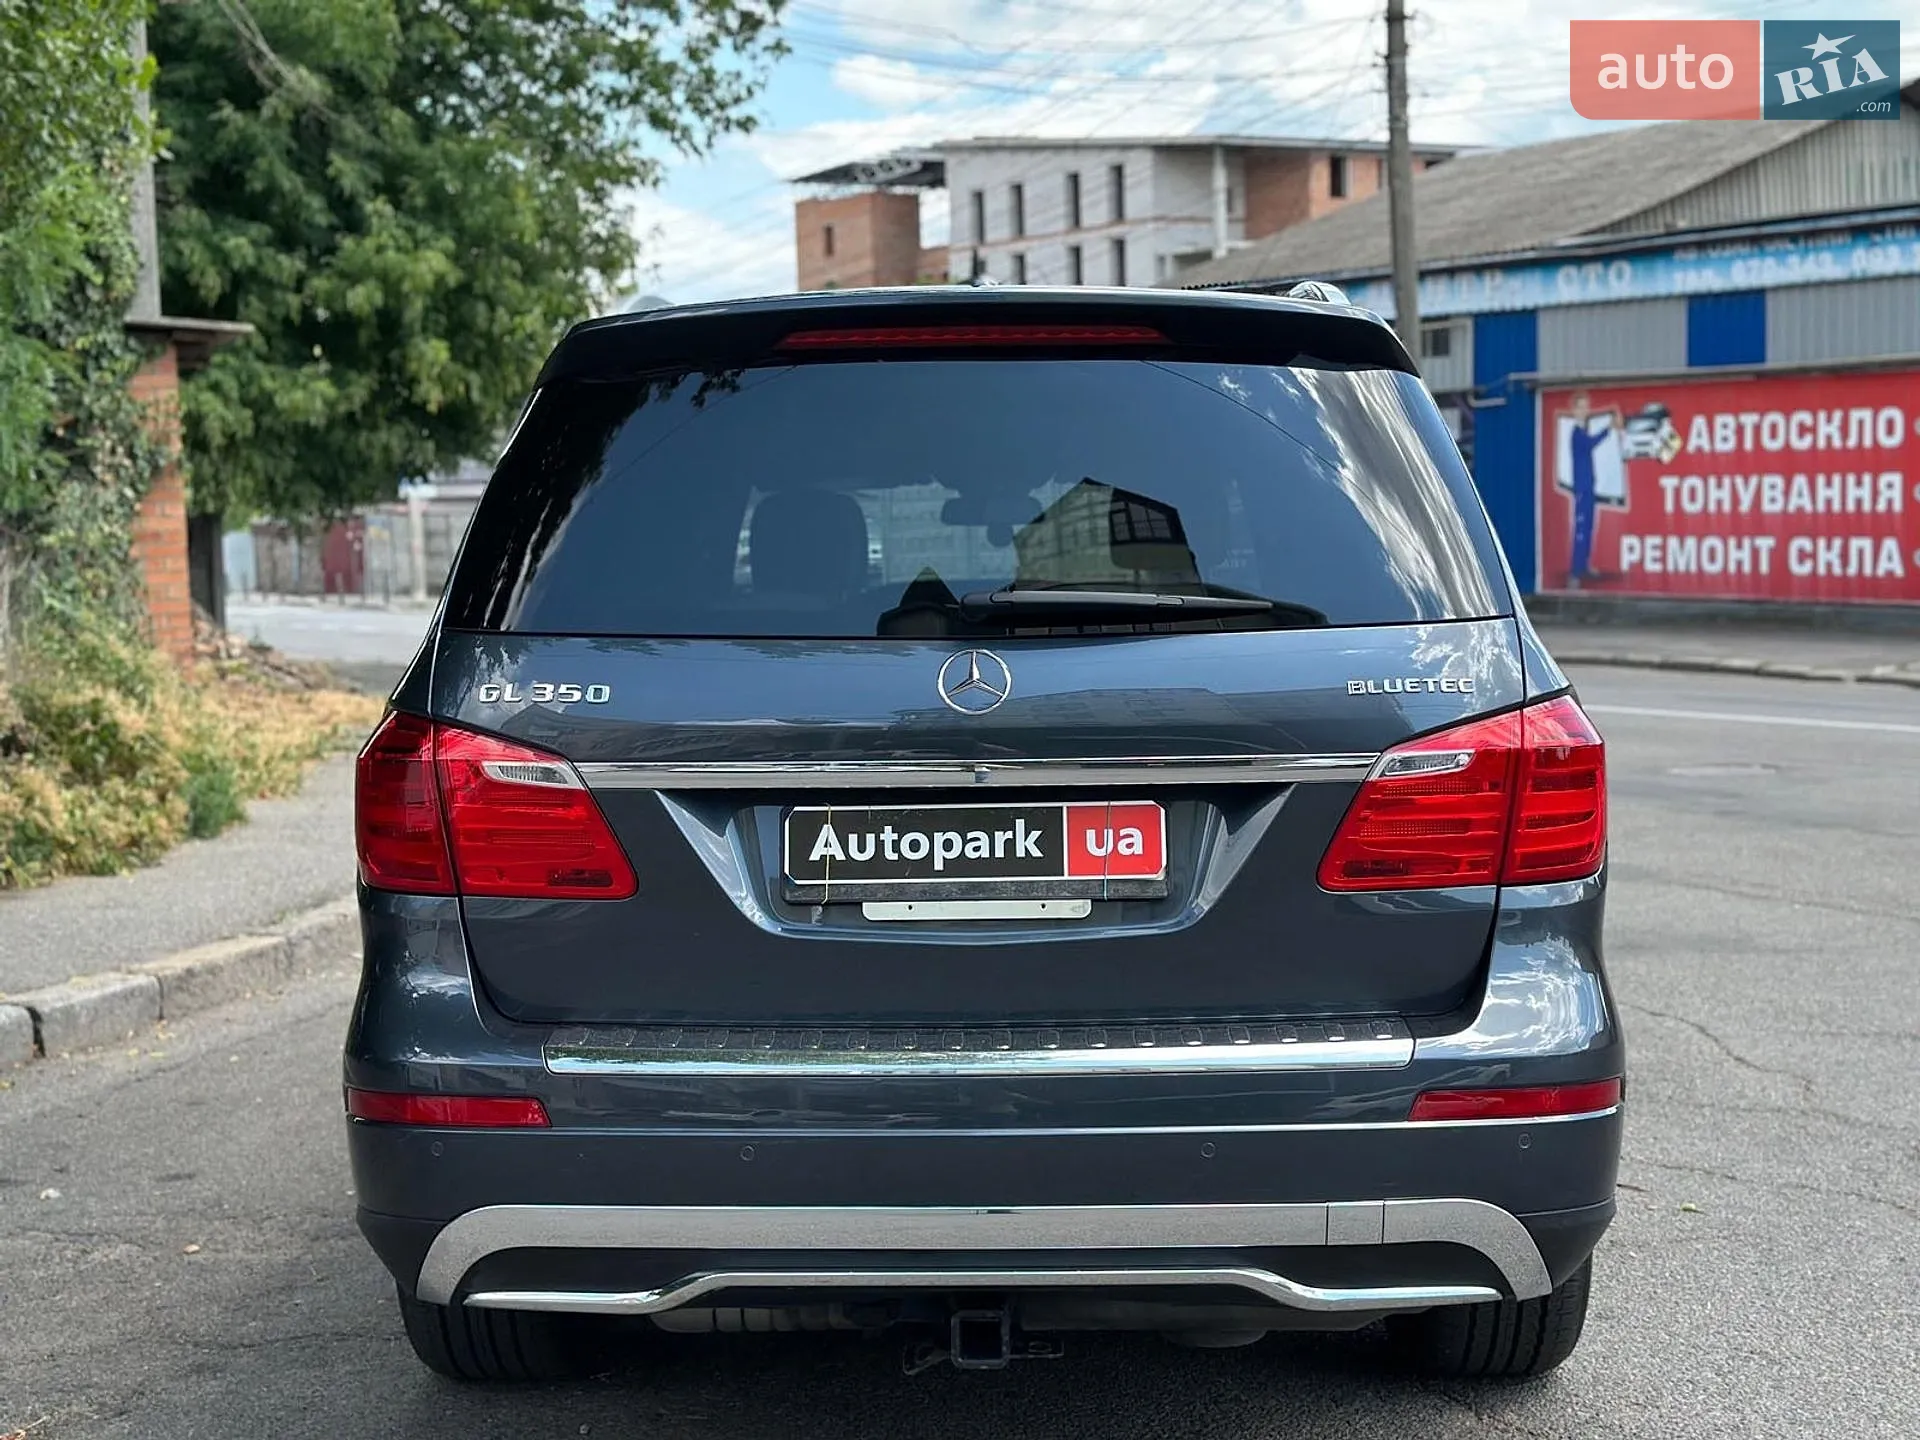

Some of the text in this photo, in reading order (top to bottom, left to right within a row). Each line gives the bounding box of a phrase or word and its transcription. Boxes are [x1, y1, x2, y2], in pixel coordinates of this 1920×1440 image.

[1686, 405, 1906, 454] АВТОСКЛО
[1658, 471, 1905, 514] ТОНУВАННЯ
[1619, 533, 1906, 578] РЕМОНТ СКЛА
[478, 683, 612, 703] GL 350
[1346, 678, 1477, 695] BLUETEC
[808, 818, 1145, 871] Autopark ua
